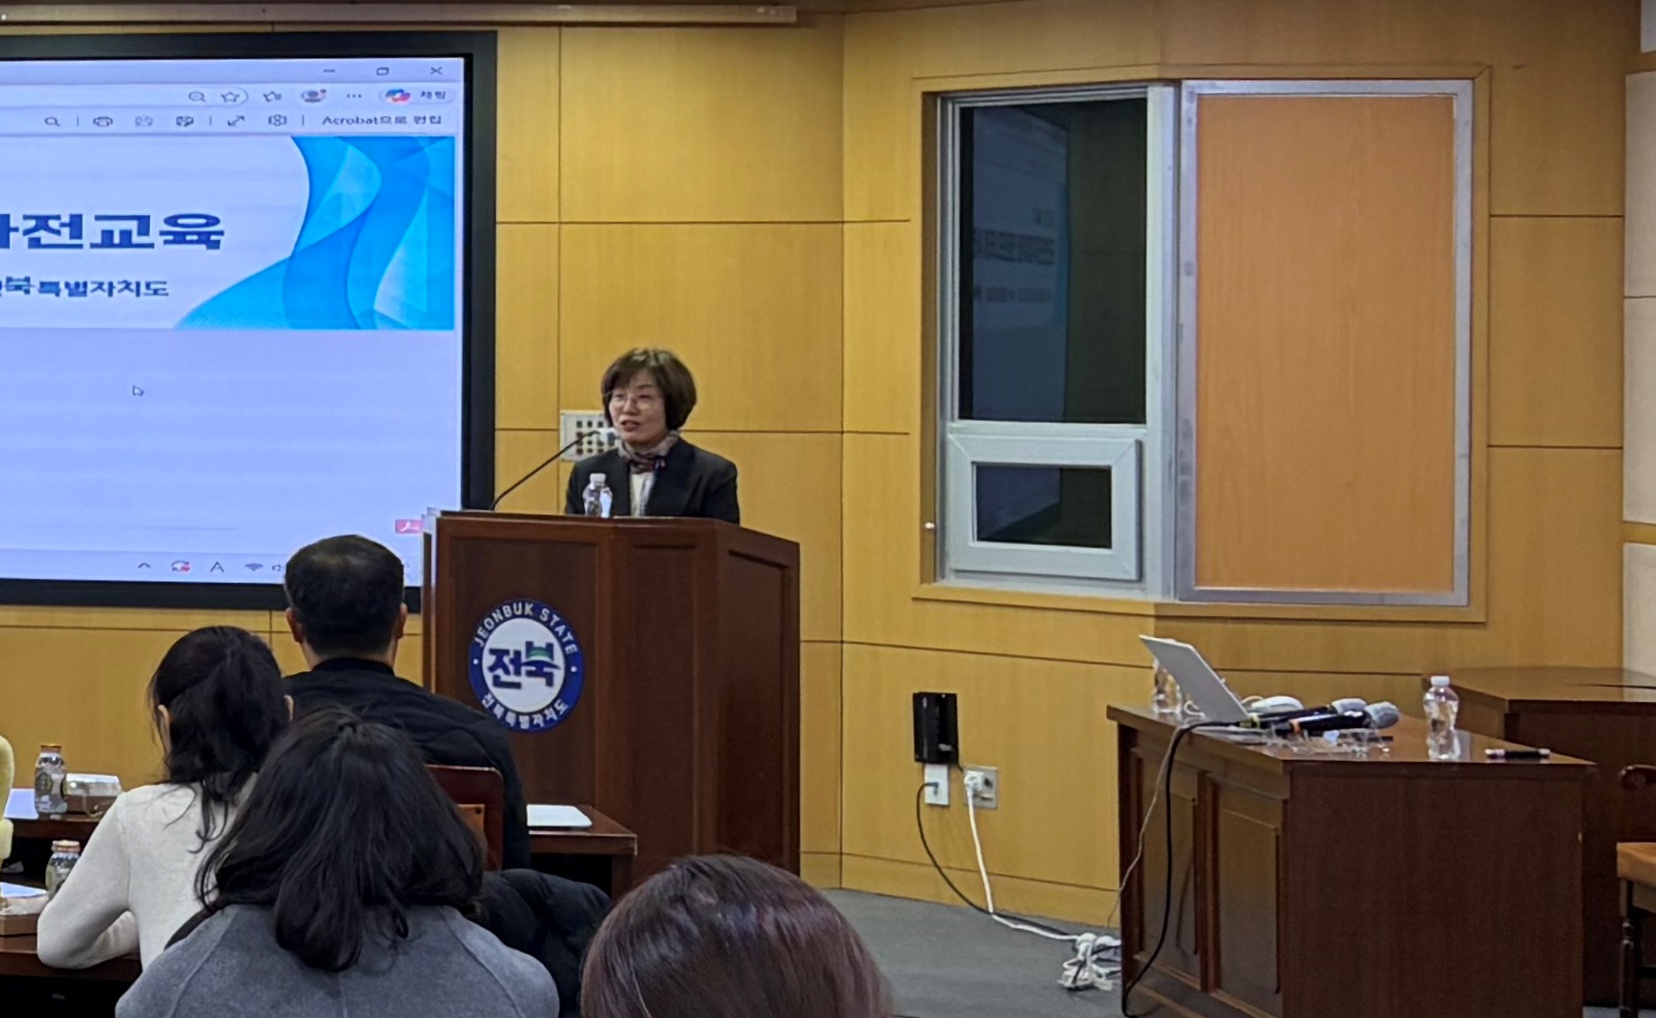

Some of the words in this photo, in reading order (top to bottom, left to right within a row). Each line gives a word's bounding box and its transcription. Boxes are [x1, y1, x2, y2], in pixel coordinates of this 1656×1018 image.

[473, 602, 535, 648] JEONBUK
[539, 607, 579, 655] STATE
[487, 640, 562, 690] 전북
[481, 692, 570, 730] 전북특별자치도
